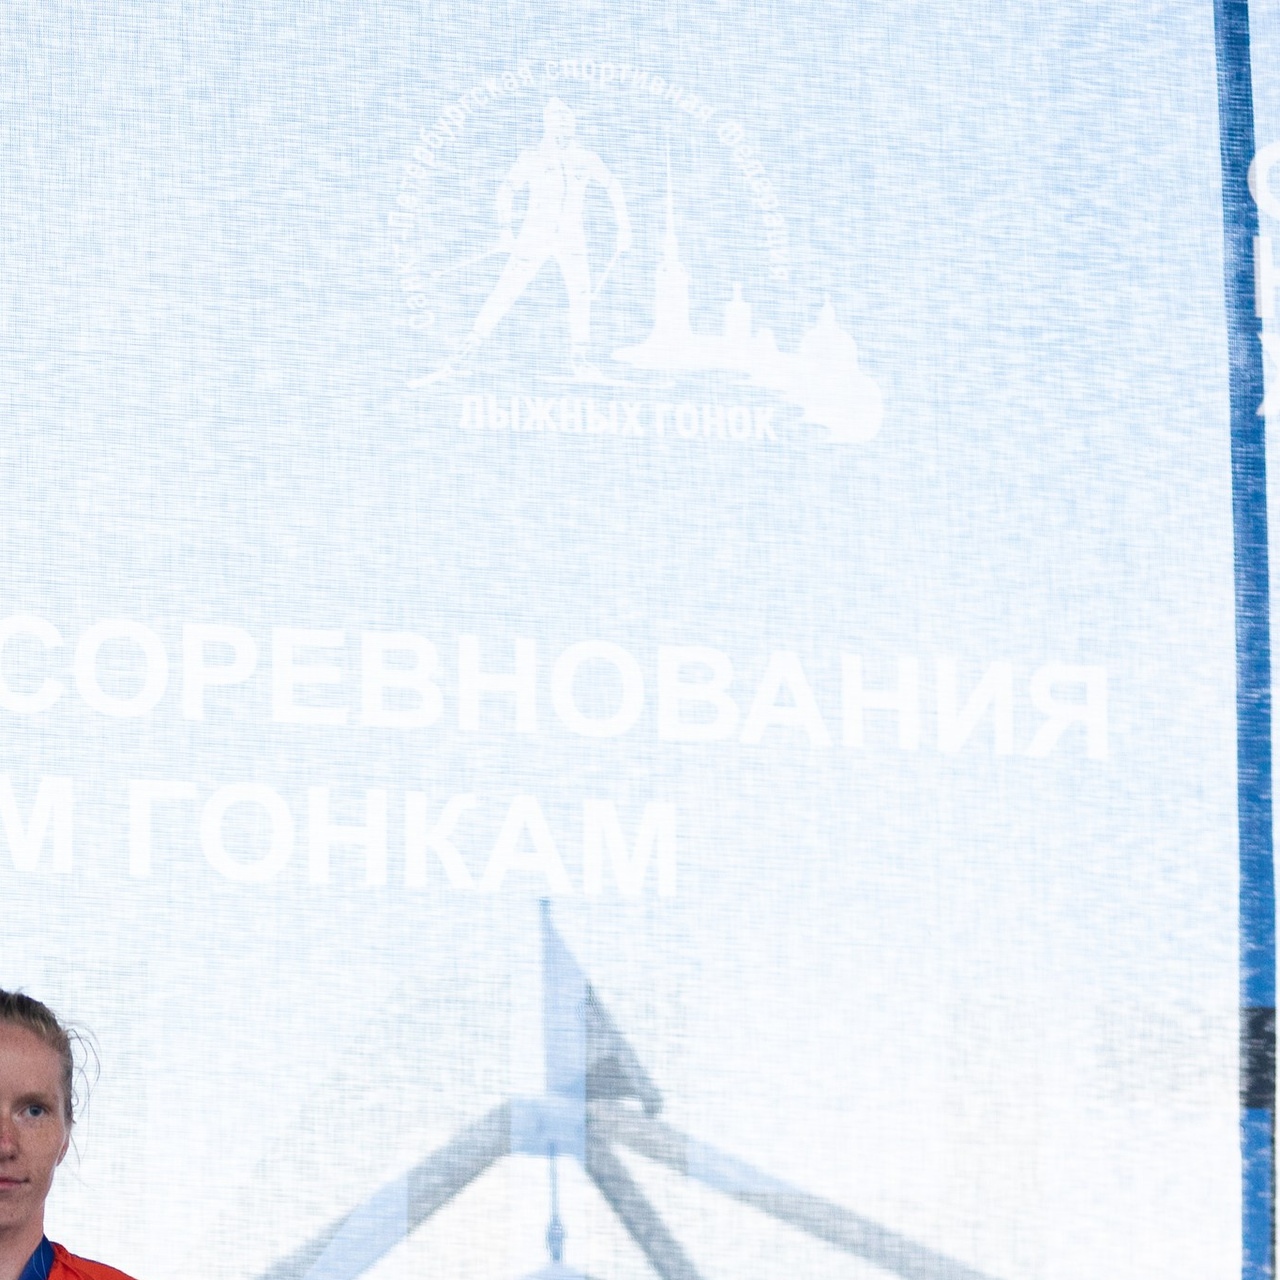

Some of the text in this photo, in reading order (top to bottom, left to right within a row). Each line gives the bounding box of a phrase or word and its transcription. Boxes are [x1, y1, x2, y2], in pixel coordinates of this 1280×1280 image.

[458, 394, 780, 441] ЛЫЖНЫХ ГОНОК
[127, 780, 678, 897] ГОНКАМ
